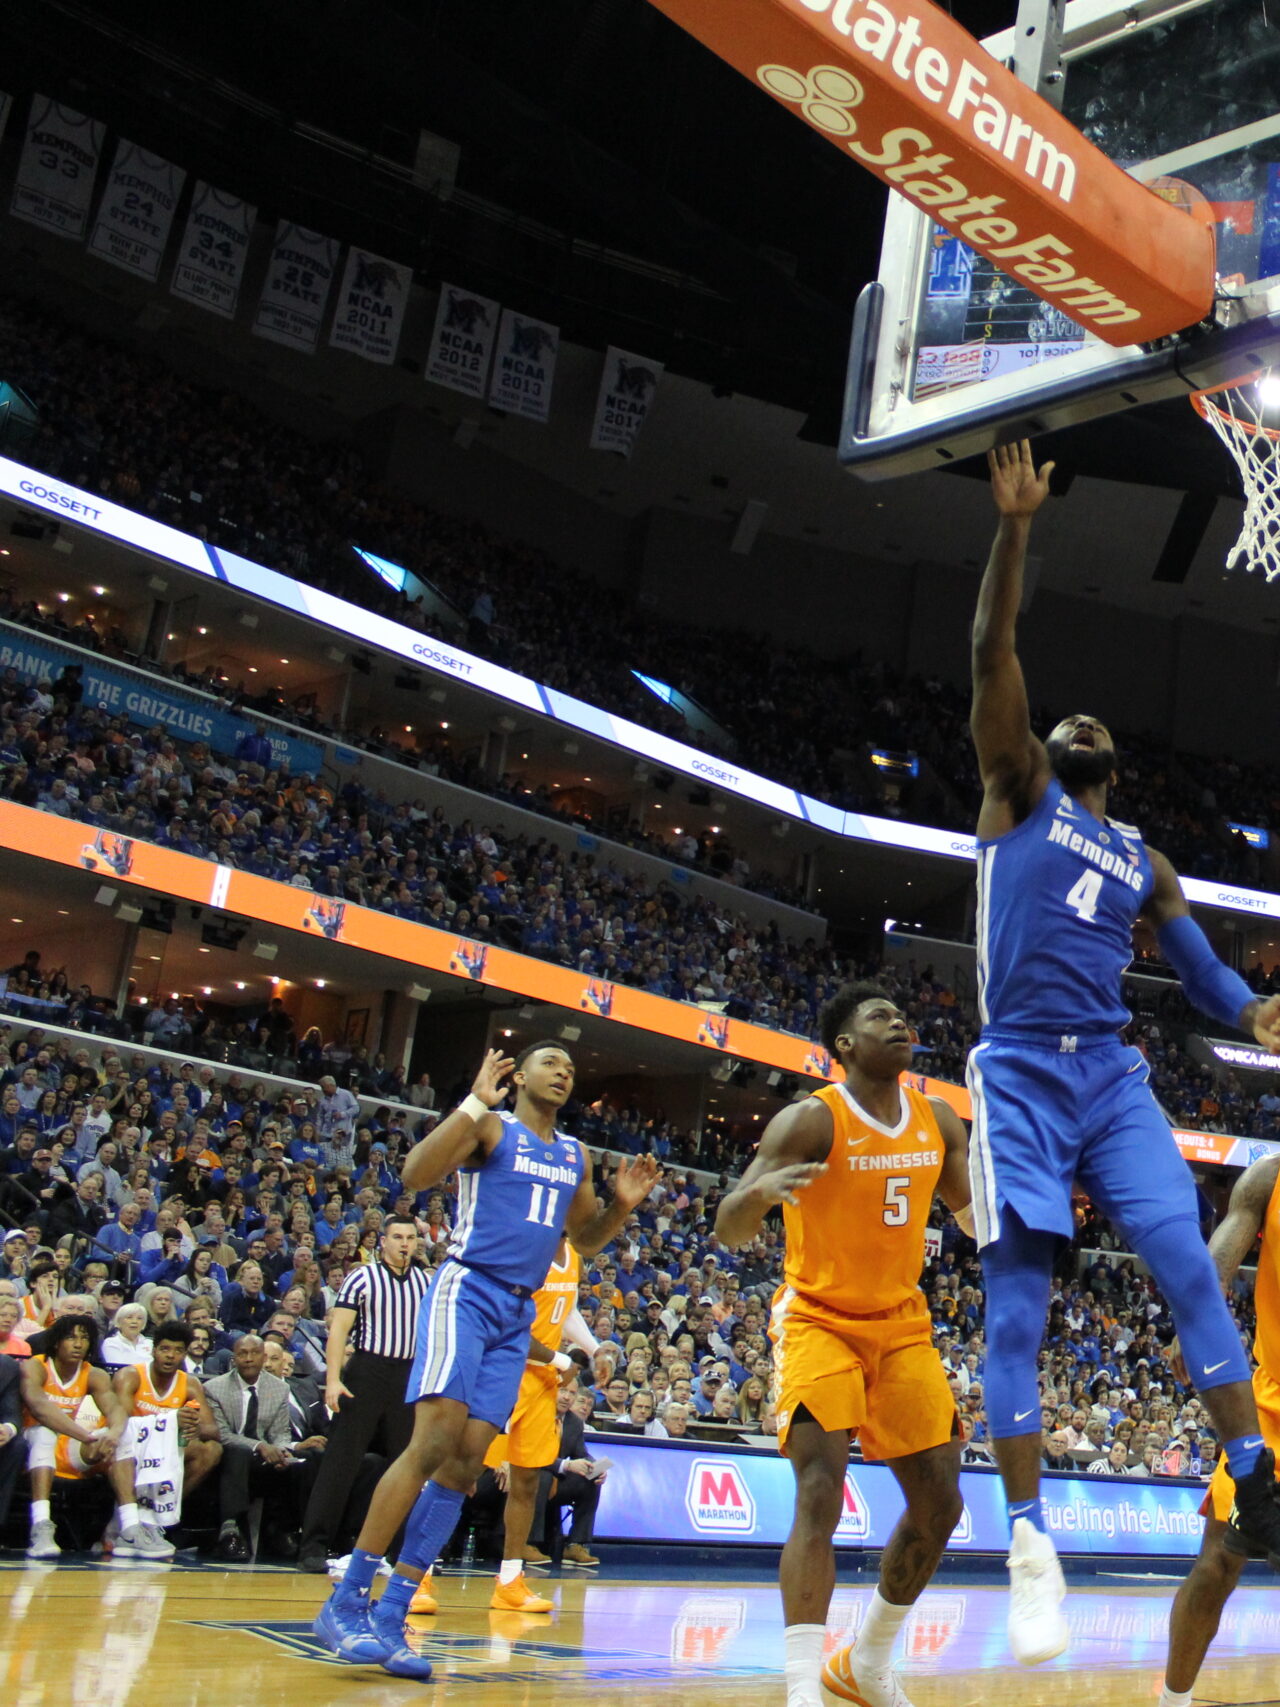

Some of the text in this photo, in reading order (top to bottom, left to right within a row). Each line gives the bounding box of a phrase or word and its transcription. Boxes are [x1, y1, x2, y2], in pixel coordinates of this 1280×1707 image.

[31, 131, 96, 169] MEMPHIS
[39, 150, 79, 179] 33
[113, 171, 174, 211] MEMPHIS
[124, 192, 153, 217] 24
[109, 206, 160, 238] STATE
[194, 212, 249, 247] MEMPHIS
[200, 231, 232, 258] 34
[189, 247, 236, 277] STATE
[274, 248, 330, 280] MEMPHIS
[272, 280, 320, 305] STATE
[348, 292, 393, 318] NCAA
[347, 310, 386, 335] 2011
[440, 330, 484, 356] NCAA
[439, 347, 479, 371] 2012
[502, 357, 545, 382] NCAA
[502, 373, 541, 396] 2013
[606, 395, 648, 416] NCAA
[20, 480, 103, 521] GOSSETT
[0, 646, 53, 681] BANK
[412, 643, 473, 666] GOSSETT
[87, 677, 213, 738] THE GRIZZLIES
[691, 760, 739, 786] GOSSETT
[1046, 818, 1144, 892] Memphis
[1066, 868, 1104, 923] 4
[1218, 893, 1268, 909] GOSSETT
[1213, 1046, 1258, 1065] KONICA
[512, 1154, 577, 1186] Memphis
[847, 1151, 939, 1171] TENNESSEE
[525, 1182, 560, 1228] 11
[882, 1176, 910, 1227] 5
[550, 1296, 567, 1324] 0
[699, 1470, 744, 1508] M
[698, 1508, 748, 1521] MARATHON
[1118, 1501, 1152, 1533] the
